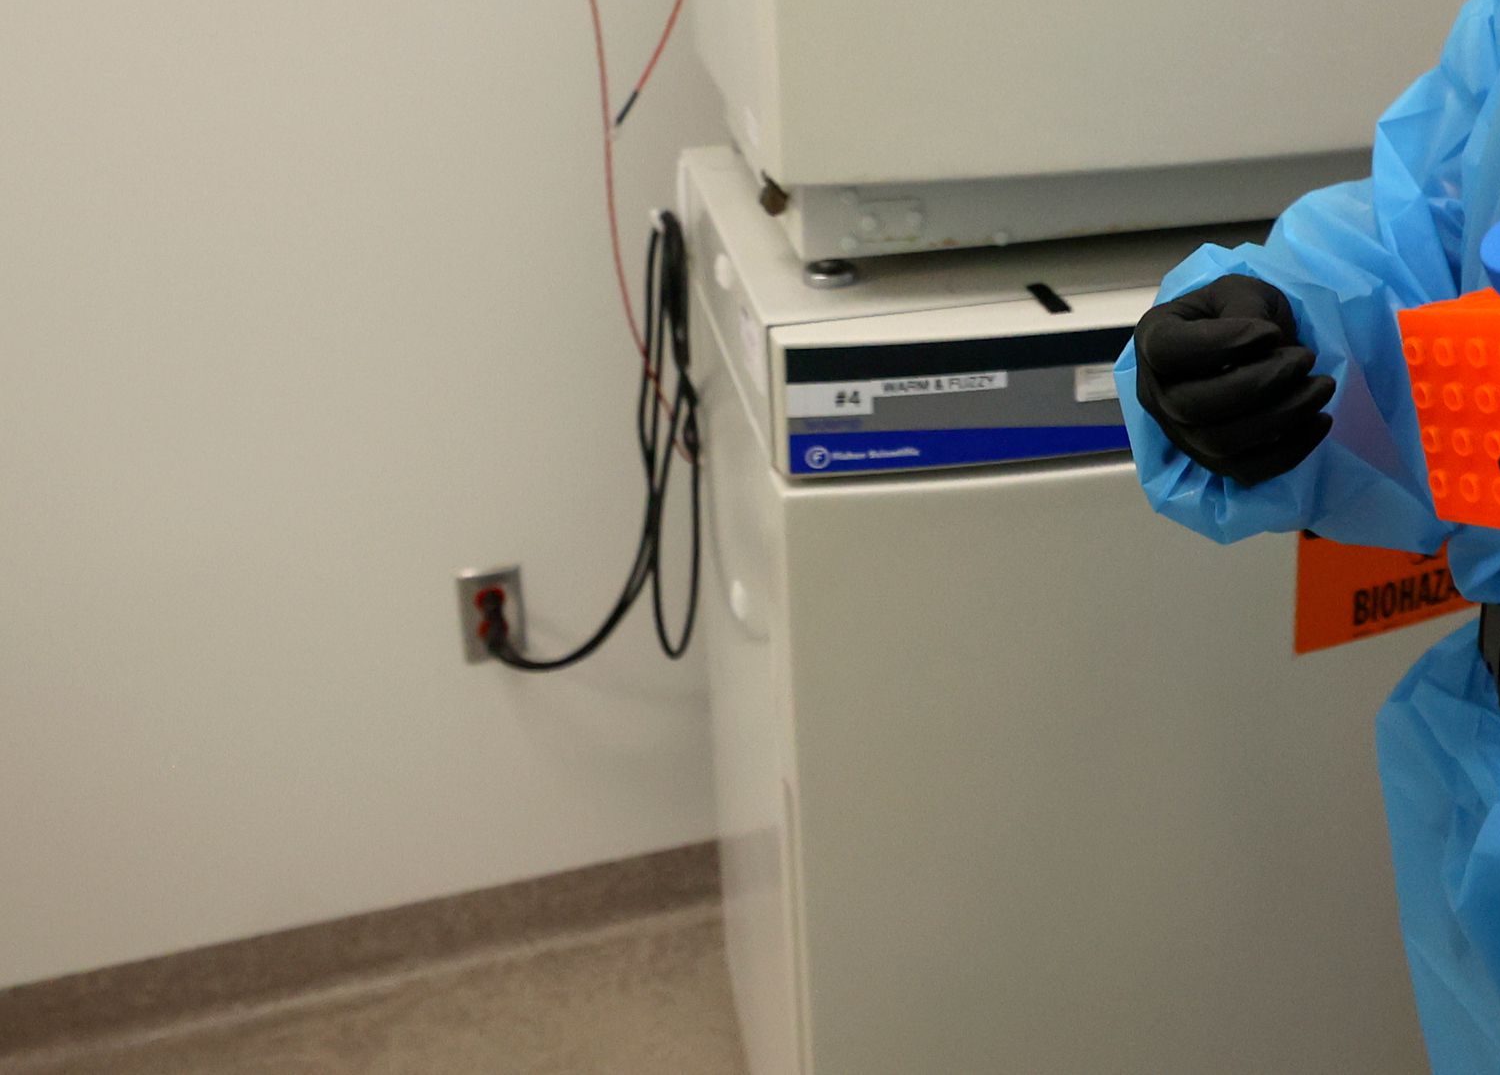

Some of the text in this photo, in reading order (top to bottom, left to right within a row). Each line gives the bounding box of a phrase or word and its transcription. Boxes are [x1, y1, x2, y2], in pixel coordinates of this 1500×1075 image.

[882, 375, 995, 394] WARM & FUZZY
[834, 389, 861, 408] #4
